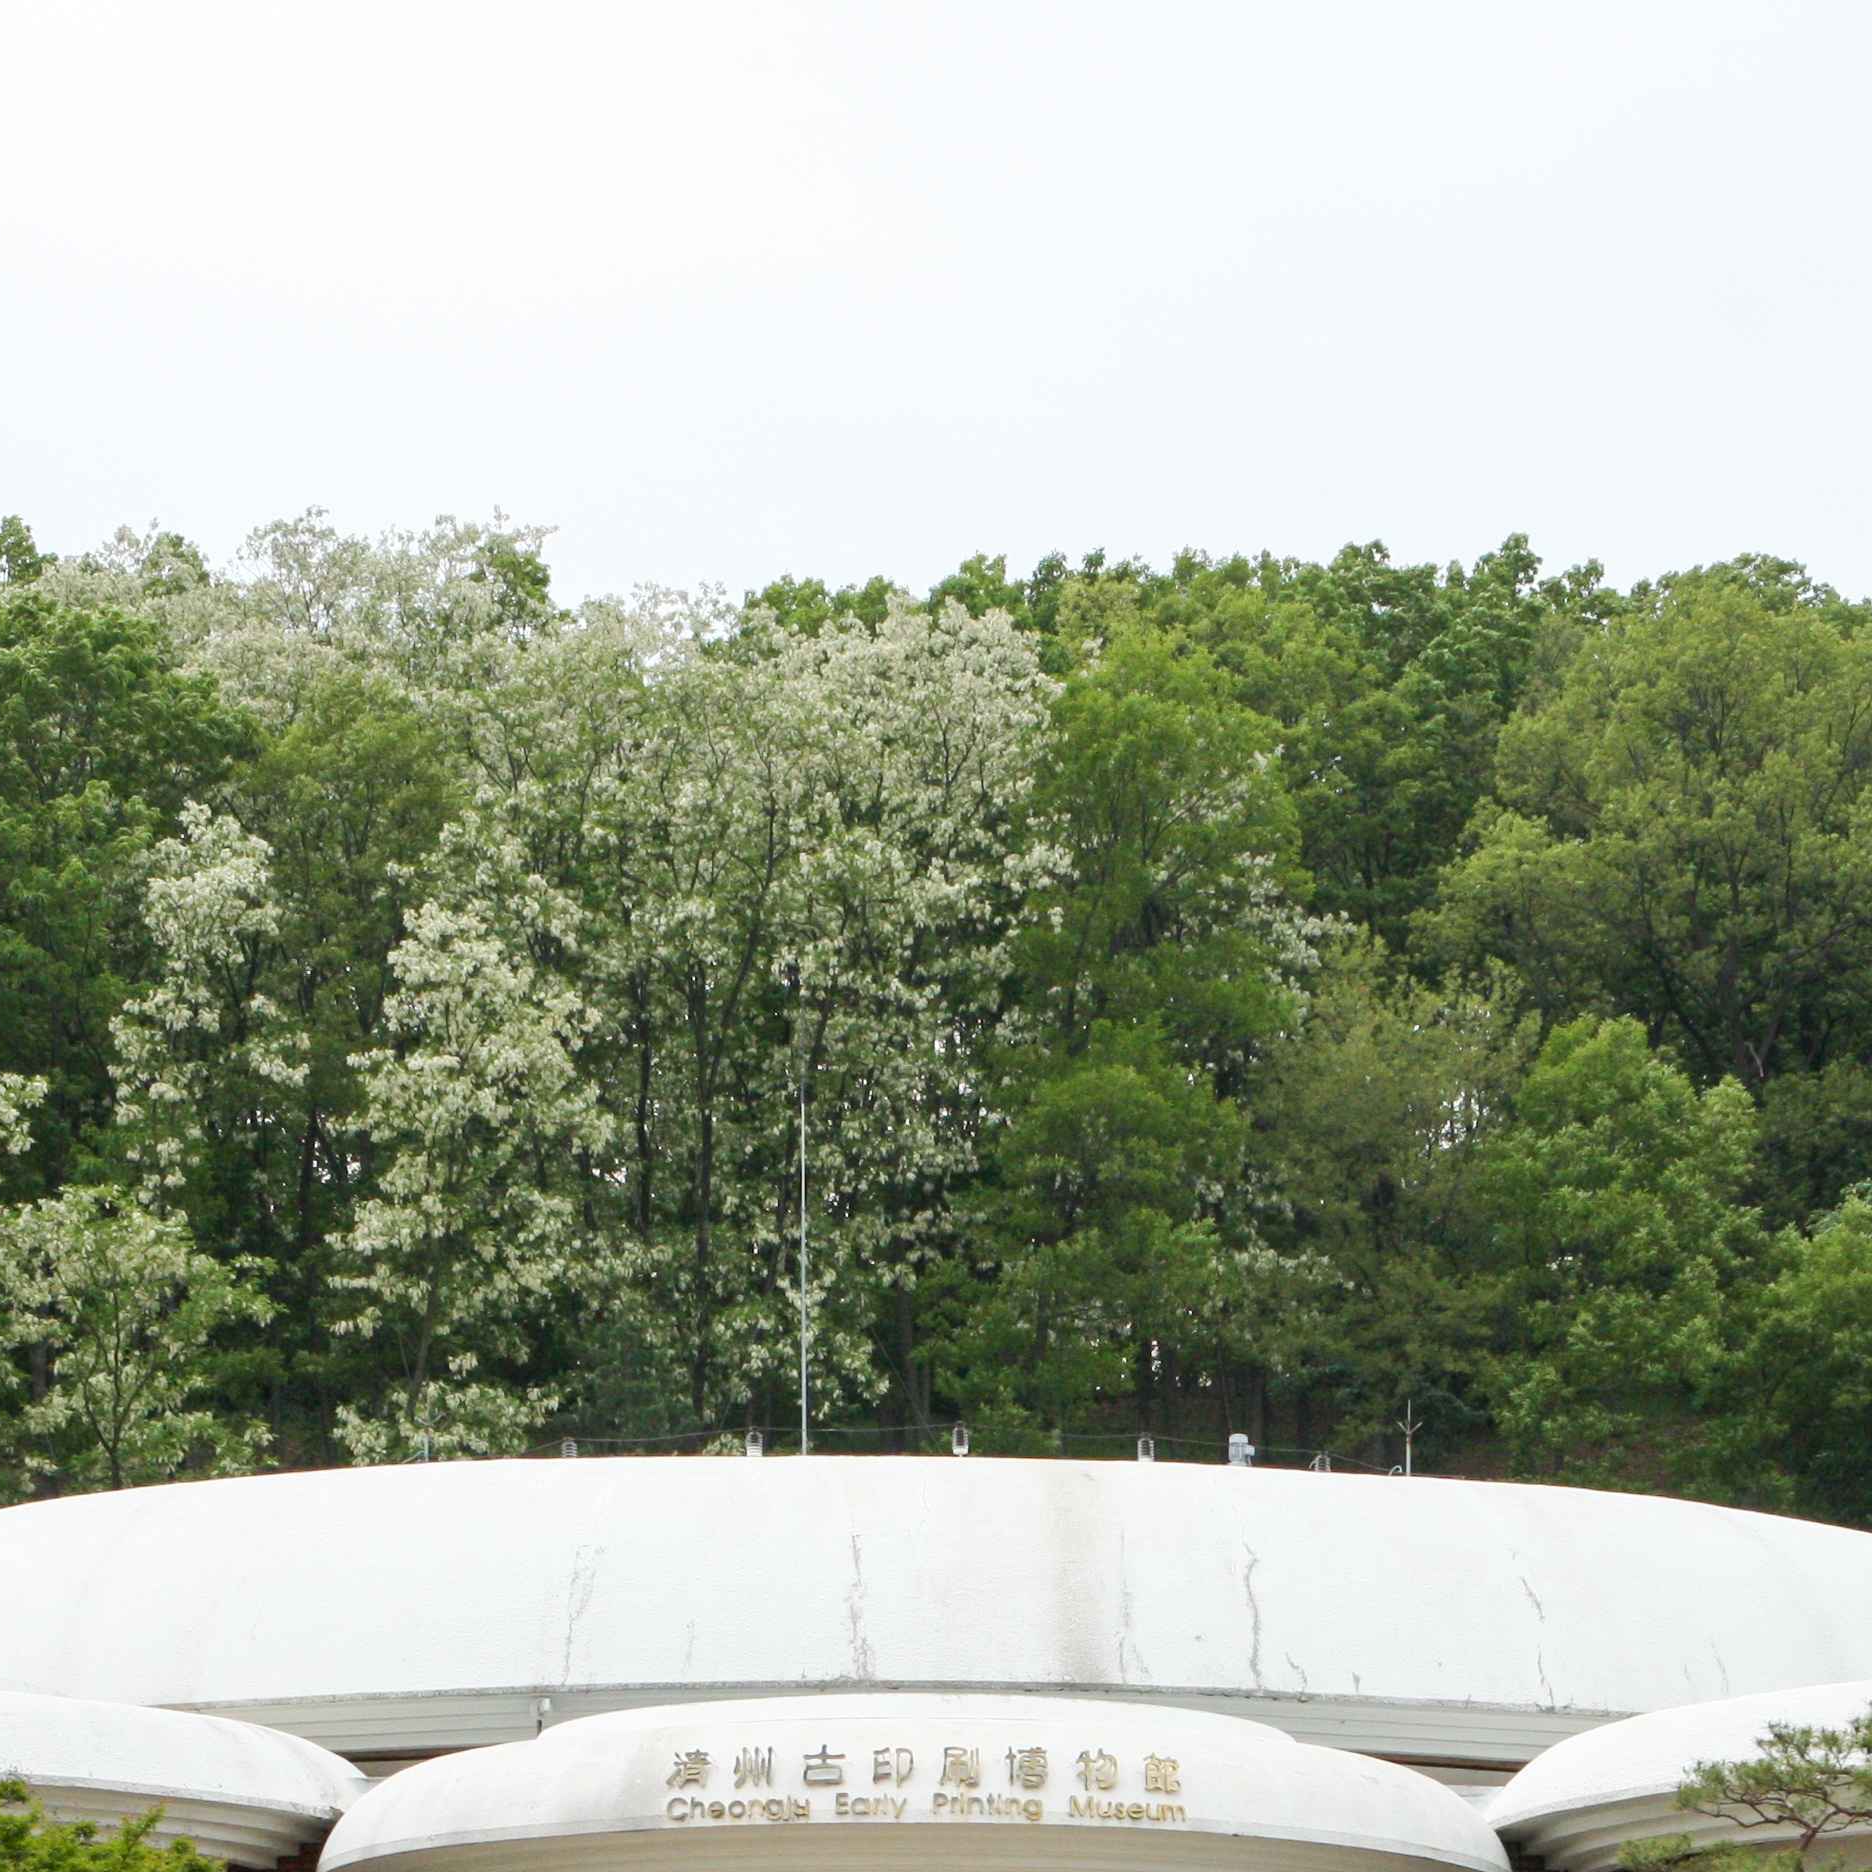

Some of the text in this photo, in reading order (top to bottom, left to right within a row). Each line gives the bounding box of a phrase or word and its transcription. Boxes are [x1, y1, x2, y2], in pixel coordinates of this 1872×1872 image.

[666, 1792, 1187, 1823] Cheongju Early Printing Museum
